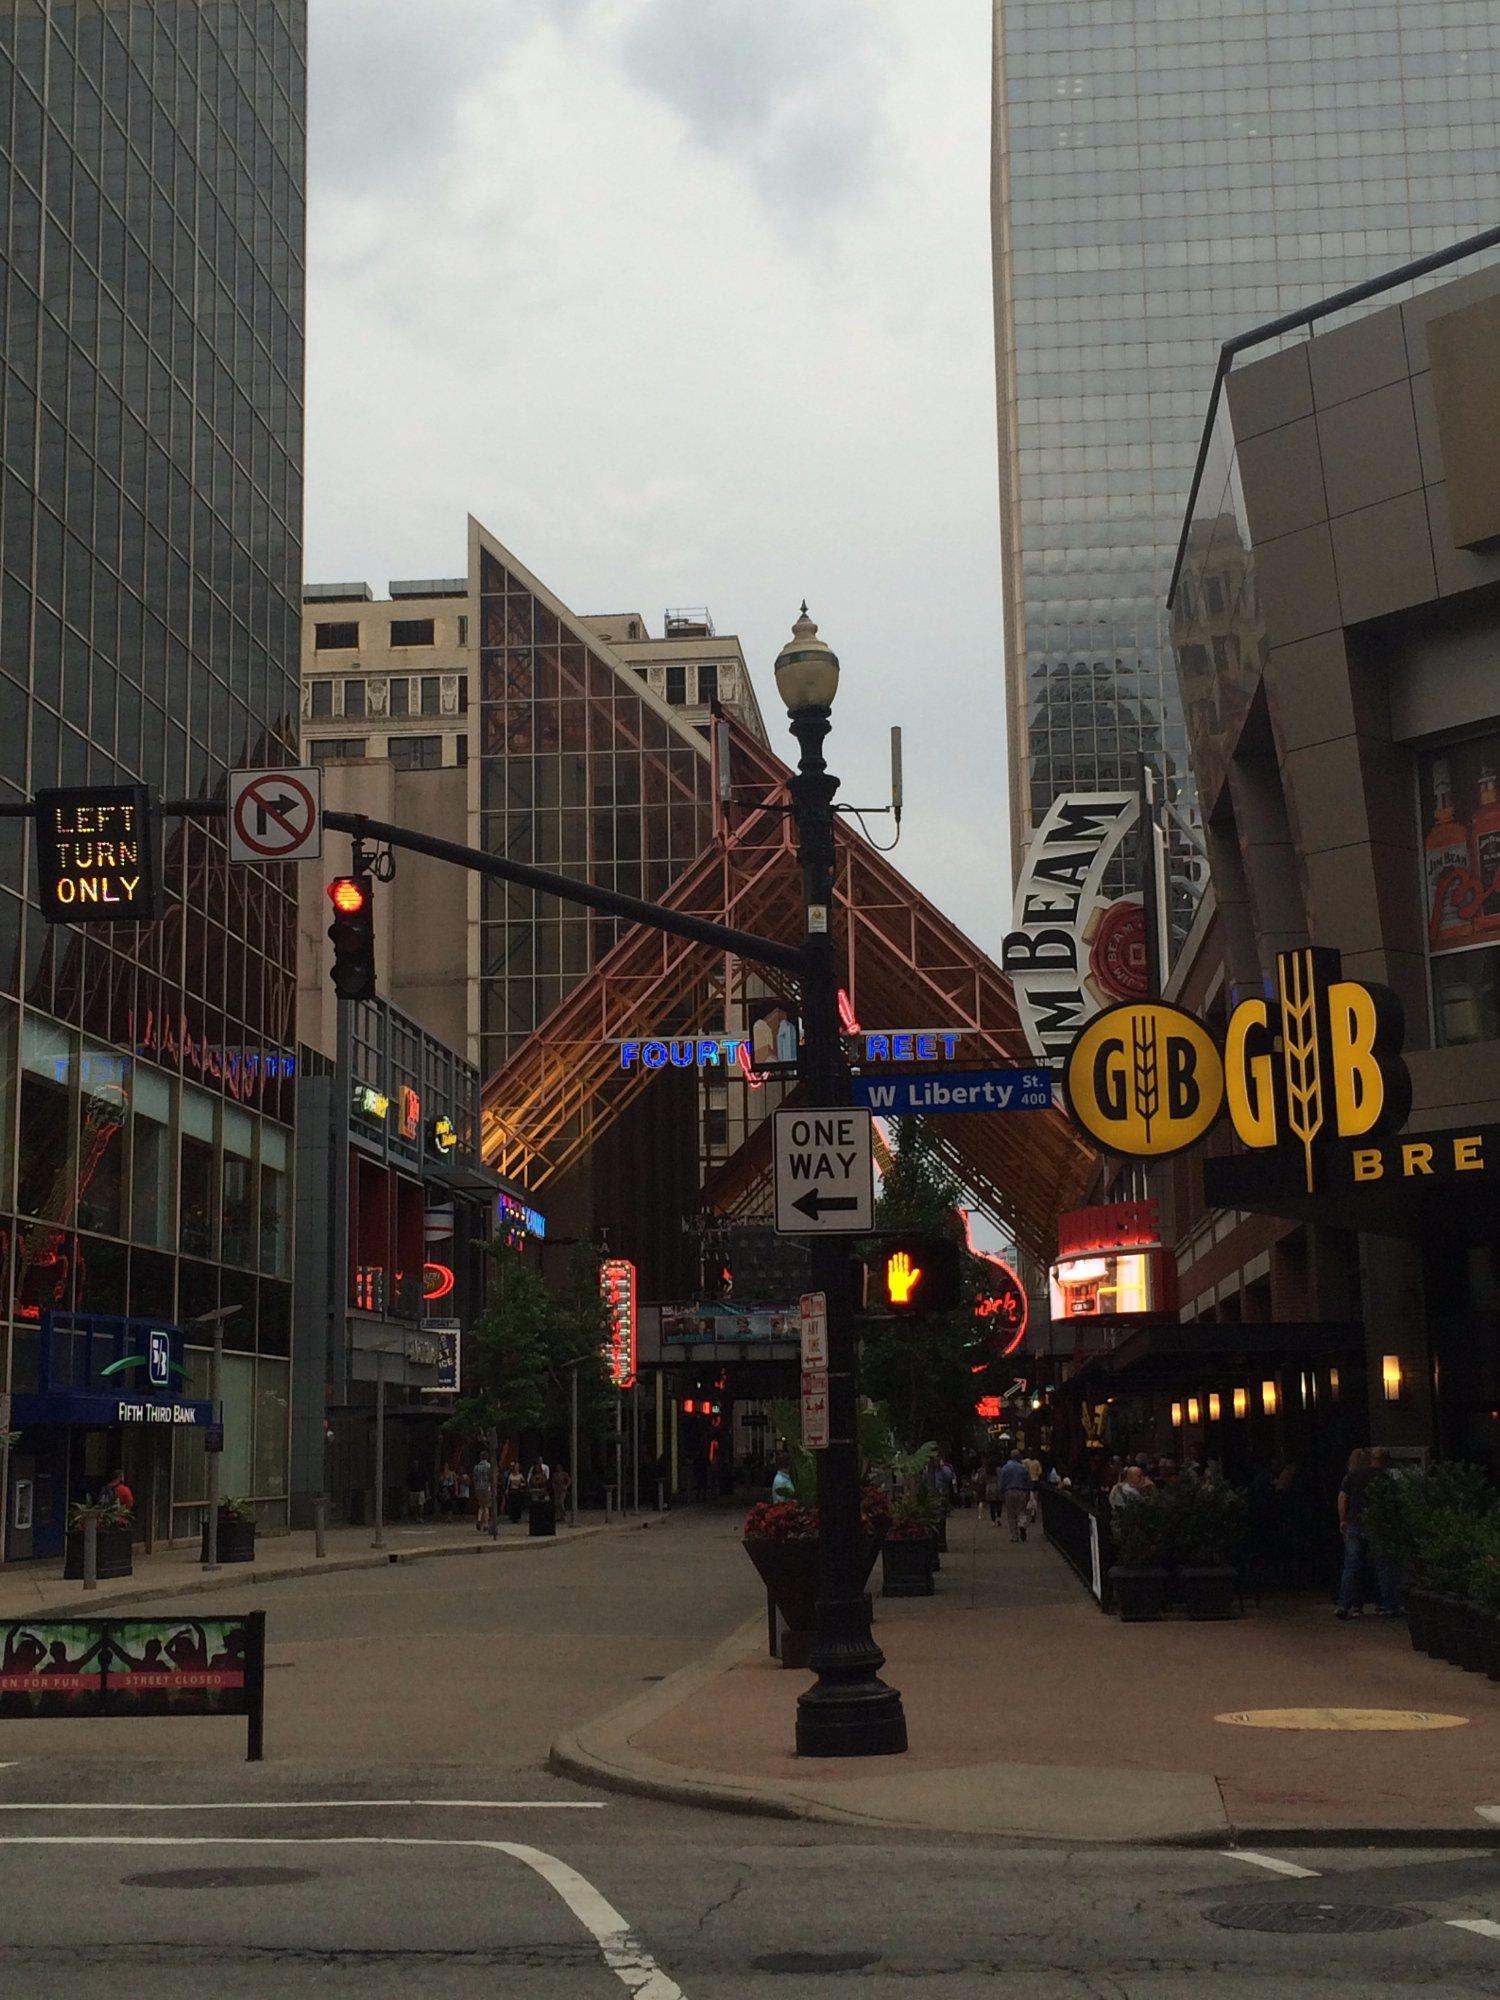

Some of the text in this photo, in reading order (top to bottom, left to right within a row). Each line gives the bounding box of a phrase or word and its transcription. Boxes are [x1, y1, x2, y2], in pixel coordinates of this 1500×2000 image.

[56, 805, 136, 833] LEFT
[56, 841, 140, 869] TURN
[1428, 852, 1467, 876] JIM BEAM
[56, 876, 141, 905] ONLY
[1003, 798, 1133, 1068] IM BEAM
[1108, 922, 1136, 987] JIM BEAM
[865, 1033, 962, 1062] REET
[867, 1074, 1044, 1109] W Liberty St.
[1020, 1092, 1047, 1106] 400
[791, 1119, 855, 1146] ONE
[789, 1152, 858, 1181] WAY
[1352, 1134, 1485, 1183] BRE
[118, 1401, 197, 1424] FIFTH THIRD BANK
[23, 1677, 49, 1689] FOR
[124, 1675, 170, 1687] STREET
